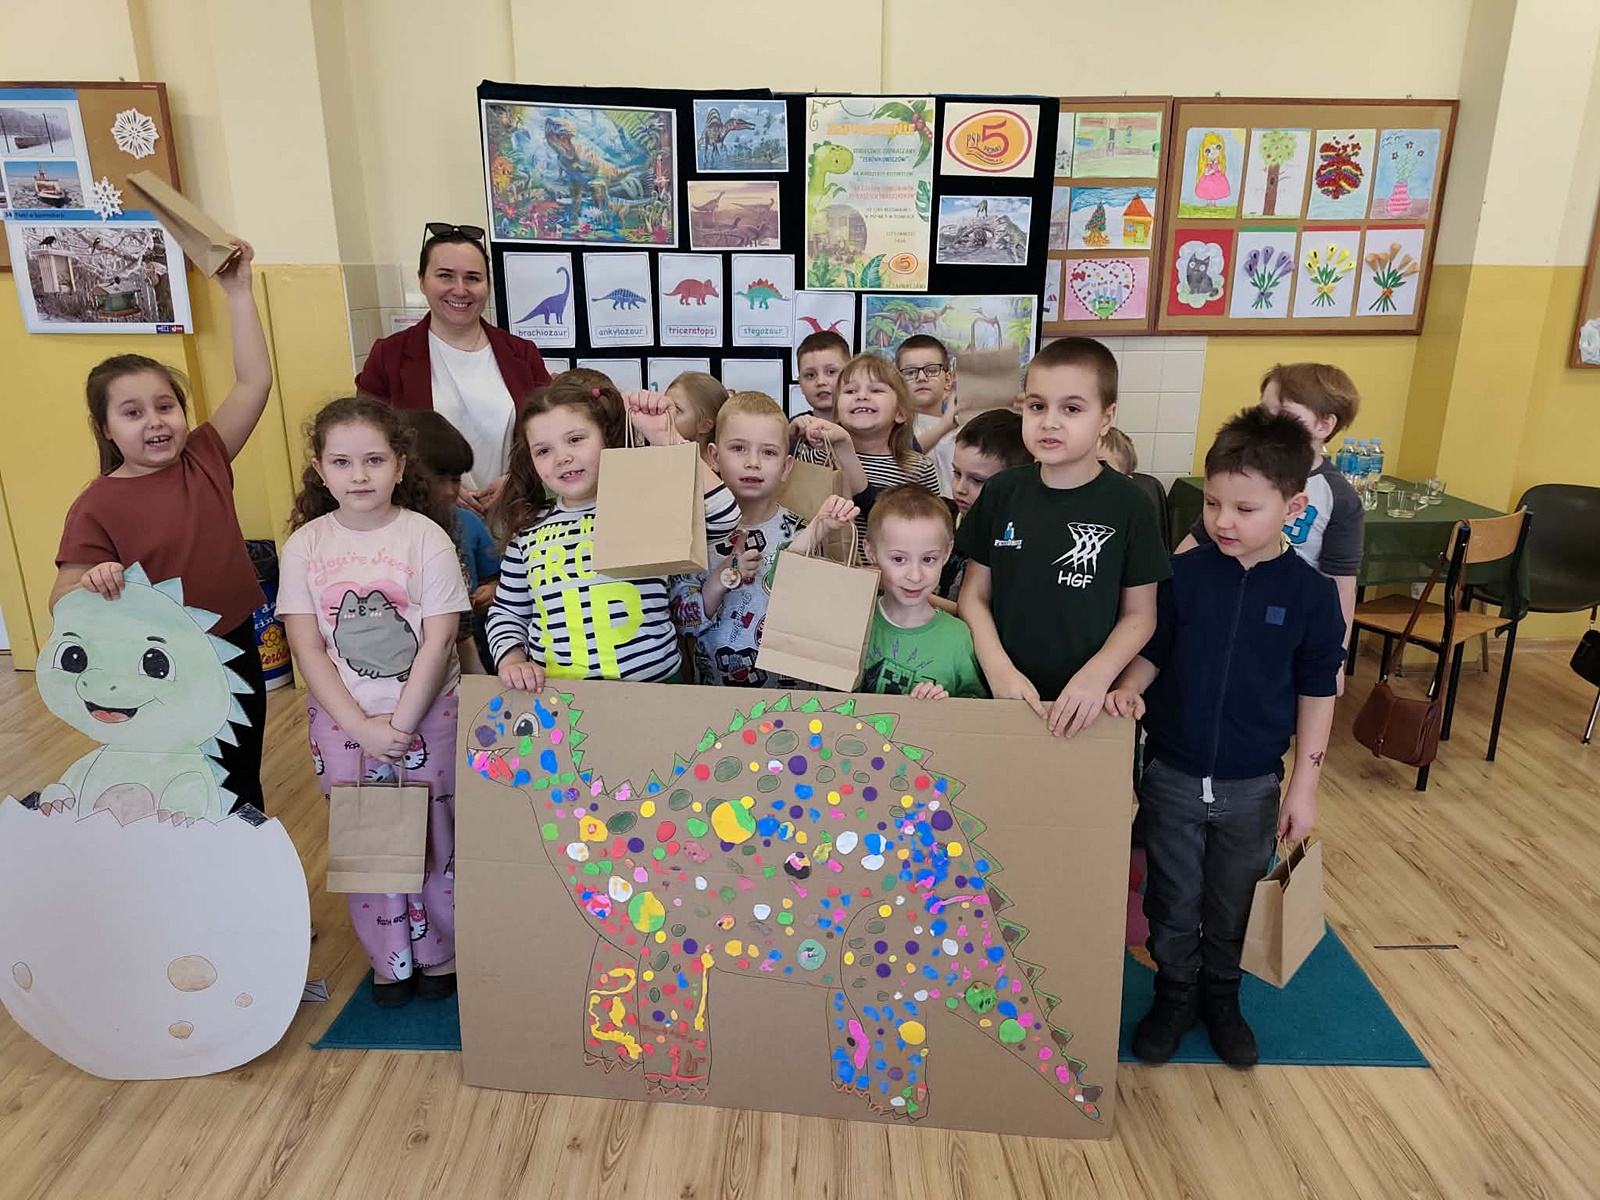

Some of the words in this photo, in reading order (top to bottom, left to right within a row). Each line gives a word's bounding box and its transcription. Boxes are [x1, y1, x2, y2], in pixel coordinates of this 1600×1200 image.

[966, 133, 981, 147] PSP
[518, 329, 567, 337] brachiozaur
[598, 327, 643, 337] ankylozaur
[668, 327, 714, 336] triceratops
[744, 327, 783, 336] stegozaur
[528, 540, 596, 590] GRO
[1057, 570, 1094, 589] HGF
[534, 581, 645, 679] UP
